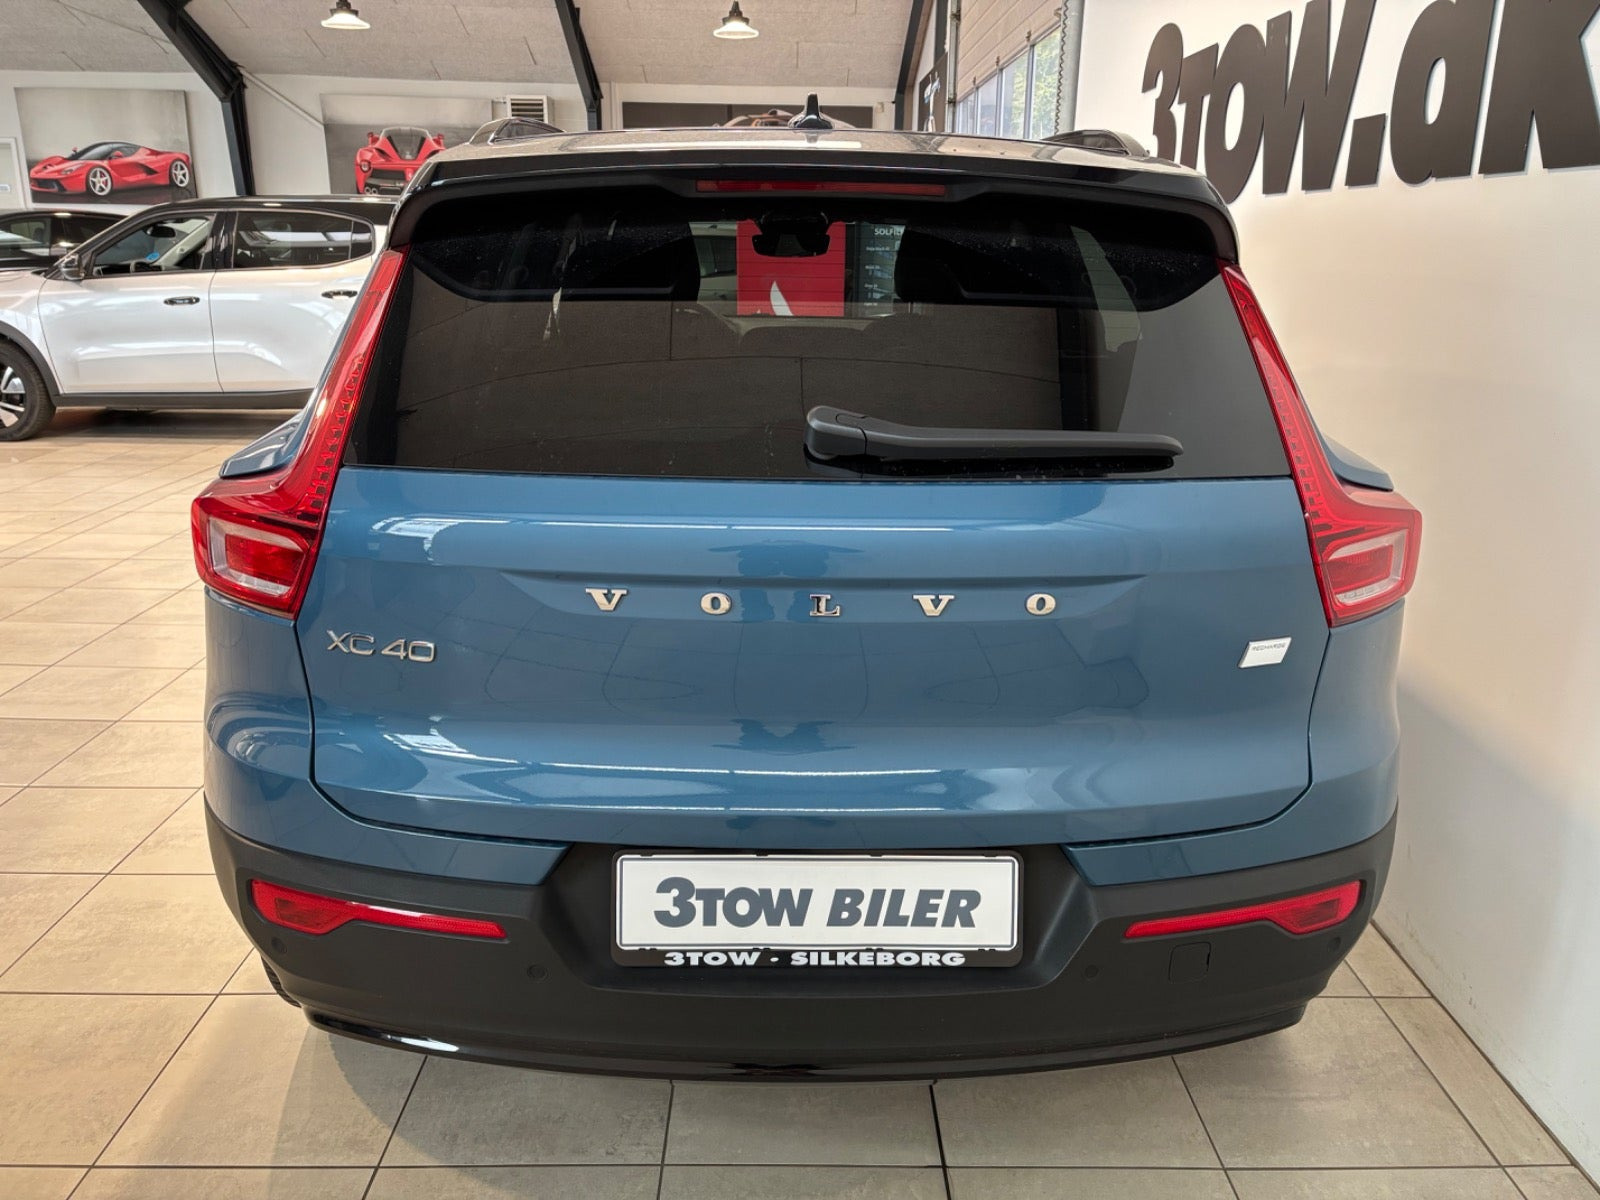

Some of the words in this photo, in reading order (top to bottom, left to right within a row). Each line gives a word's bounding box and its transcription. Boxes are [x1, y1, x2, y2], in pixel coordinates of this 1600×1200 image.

[584, 586, 1057, 618] VOLVO
[653, 876, 813, 928] 3TOW
[826, 888, 982, 928] BILER
[664, 951, 762, 967] 3TOW
[790, 951, 966, 967] SILKEBORG
